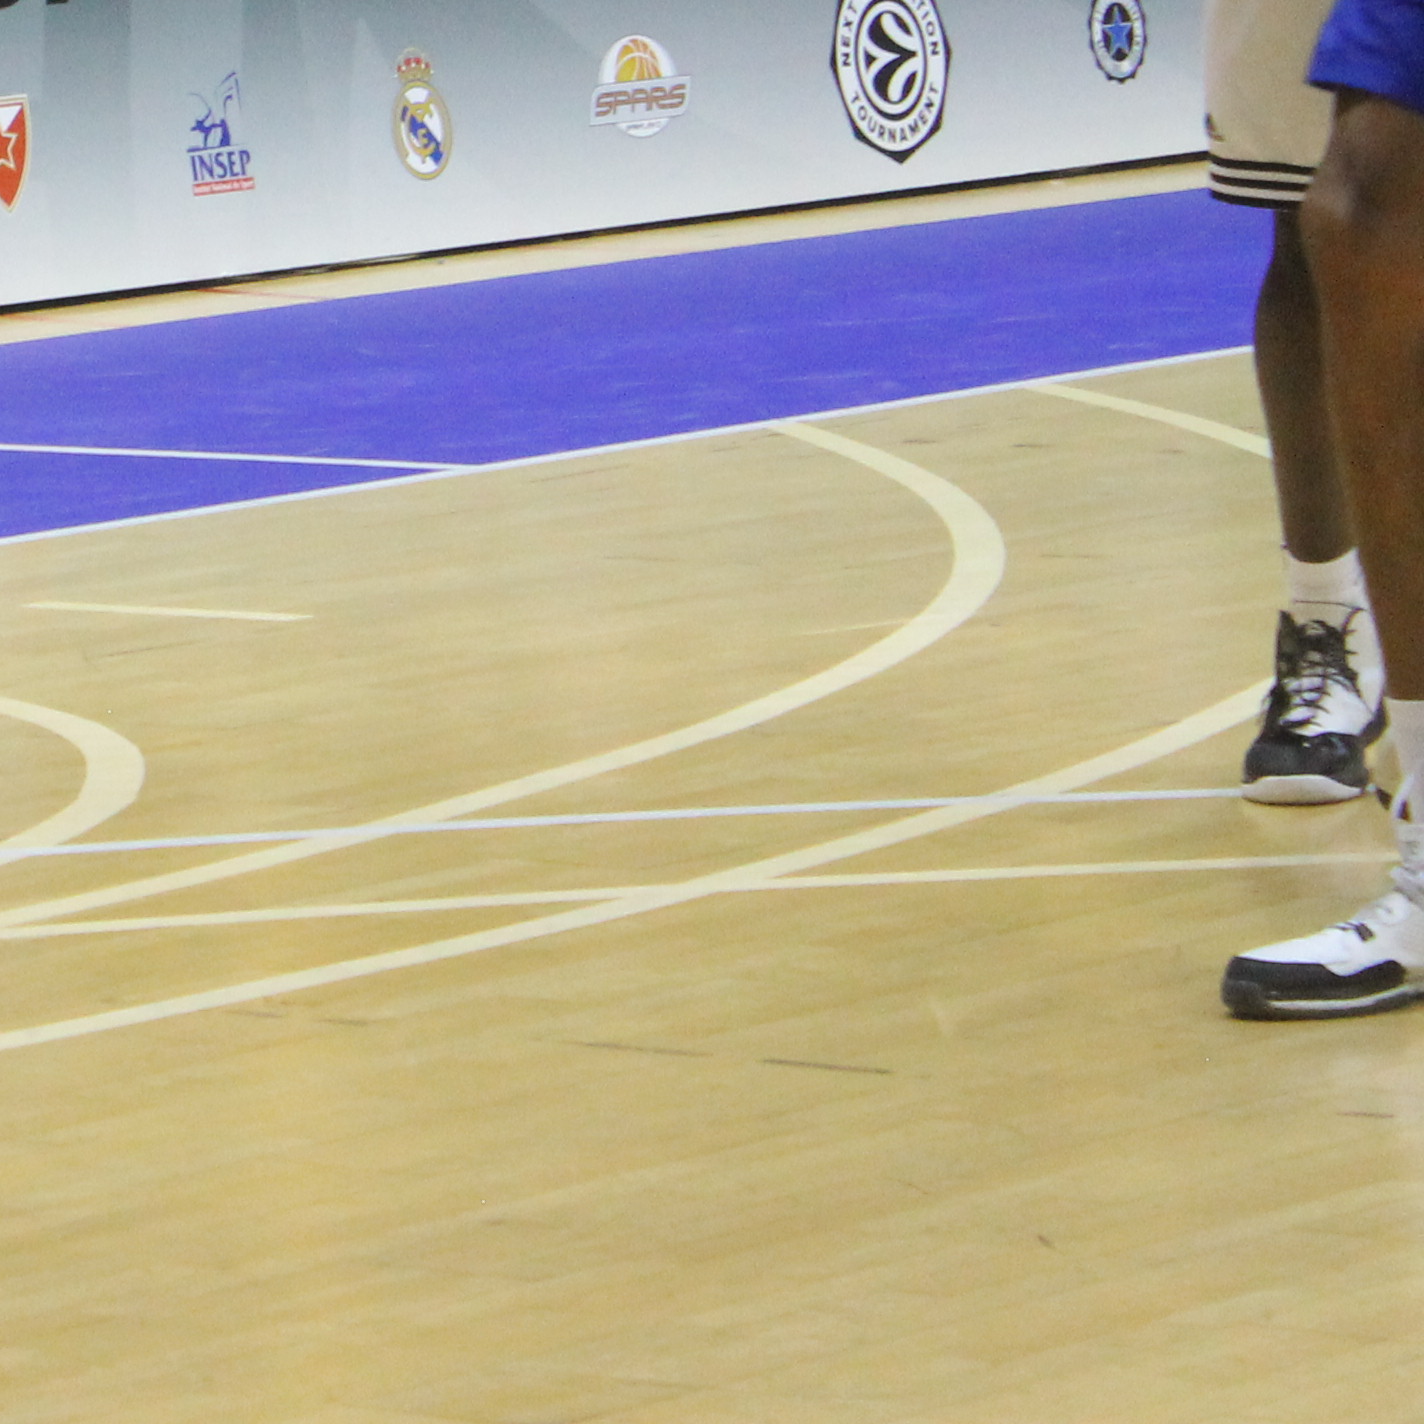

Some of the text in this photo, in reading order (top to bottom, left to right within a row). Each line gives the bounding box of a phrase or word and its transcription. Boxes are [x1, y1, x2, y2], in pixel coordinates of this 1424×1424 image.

[841, 0, 858, 67] NEXT
[595, 83, 687, 117] SPARS
[851, 81, 940, 143] TOURNAMENT
[190, 149, 251, 181] INSEP
